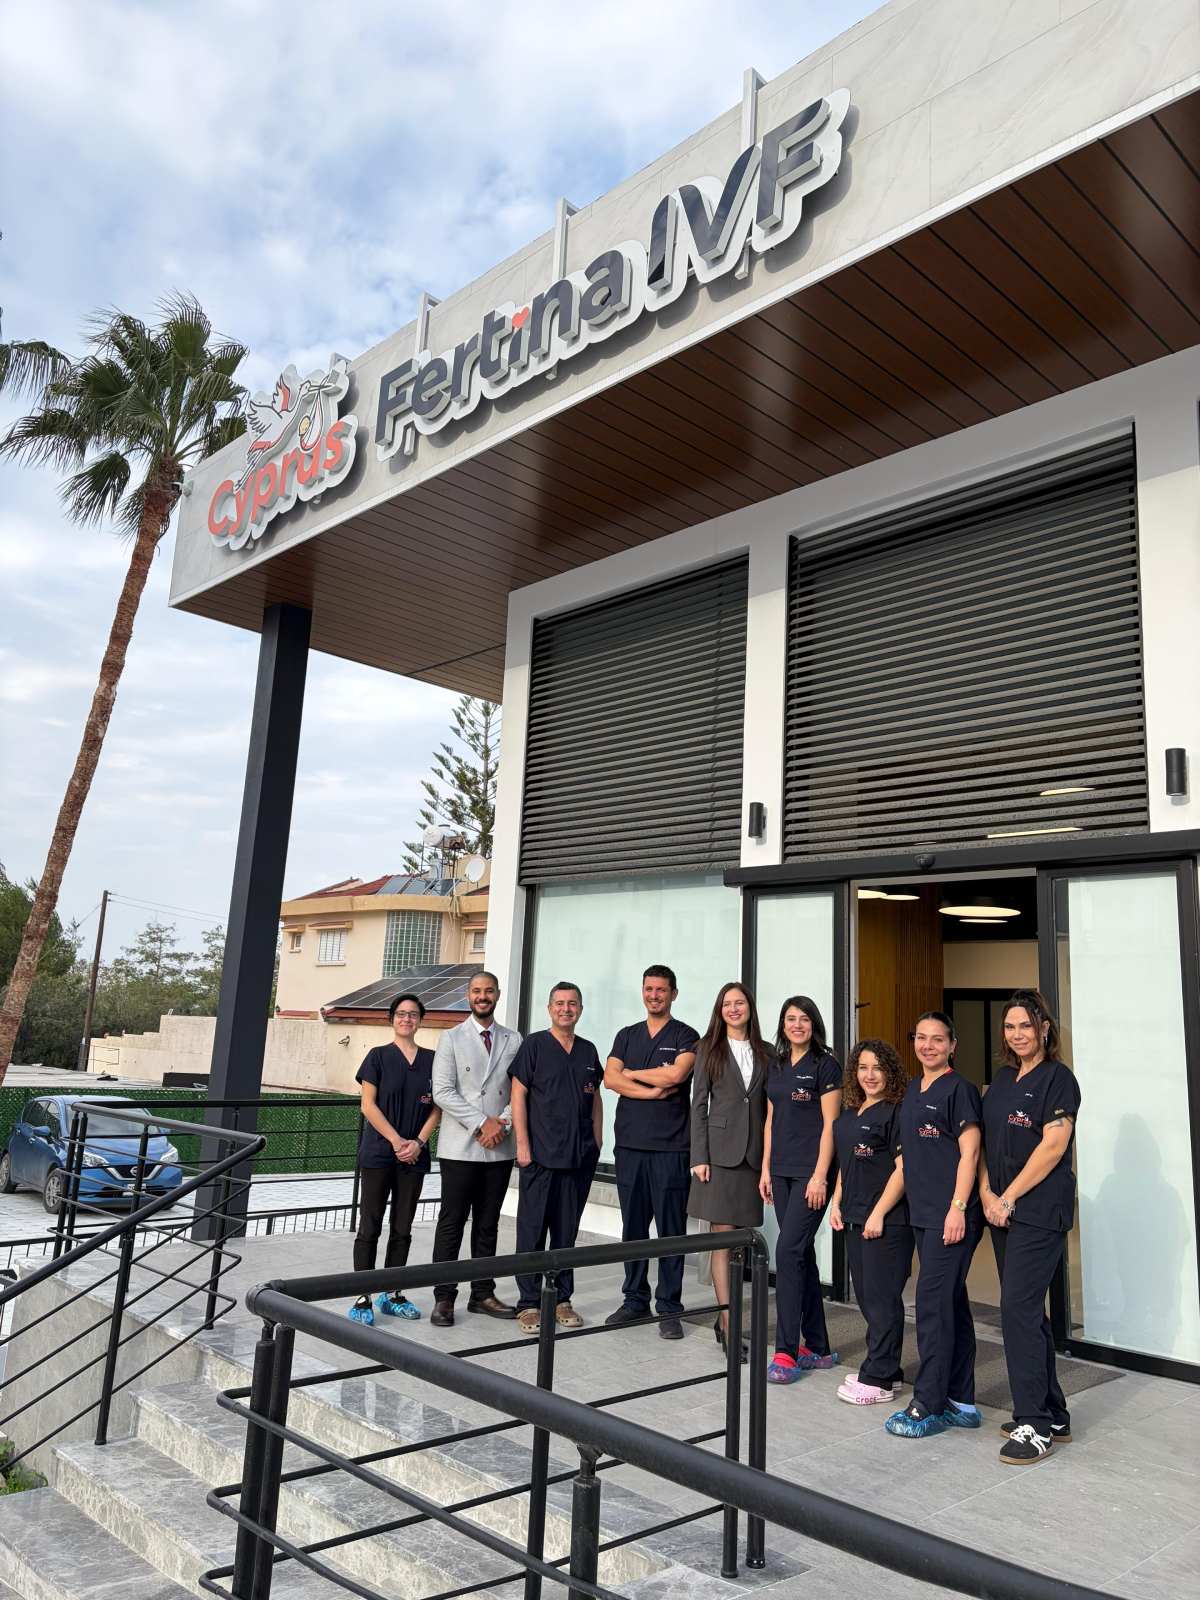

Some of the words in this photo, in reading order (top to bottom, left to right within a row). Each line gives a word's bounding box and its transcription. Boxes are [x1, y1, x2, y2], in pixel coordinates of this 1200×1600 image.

[208, 420, 350, 536] Cyprus
[375, 248, 632, 447] Fertina
[647, 97, 830, 291] IVF
